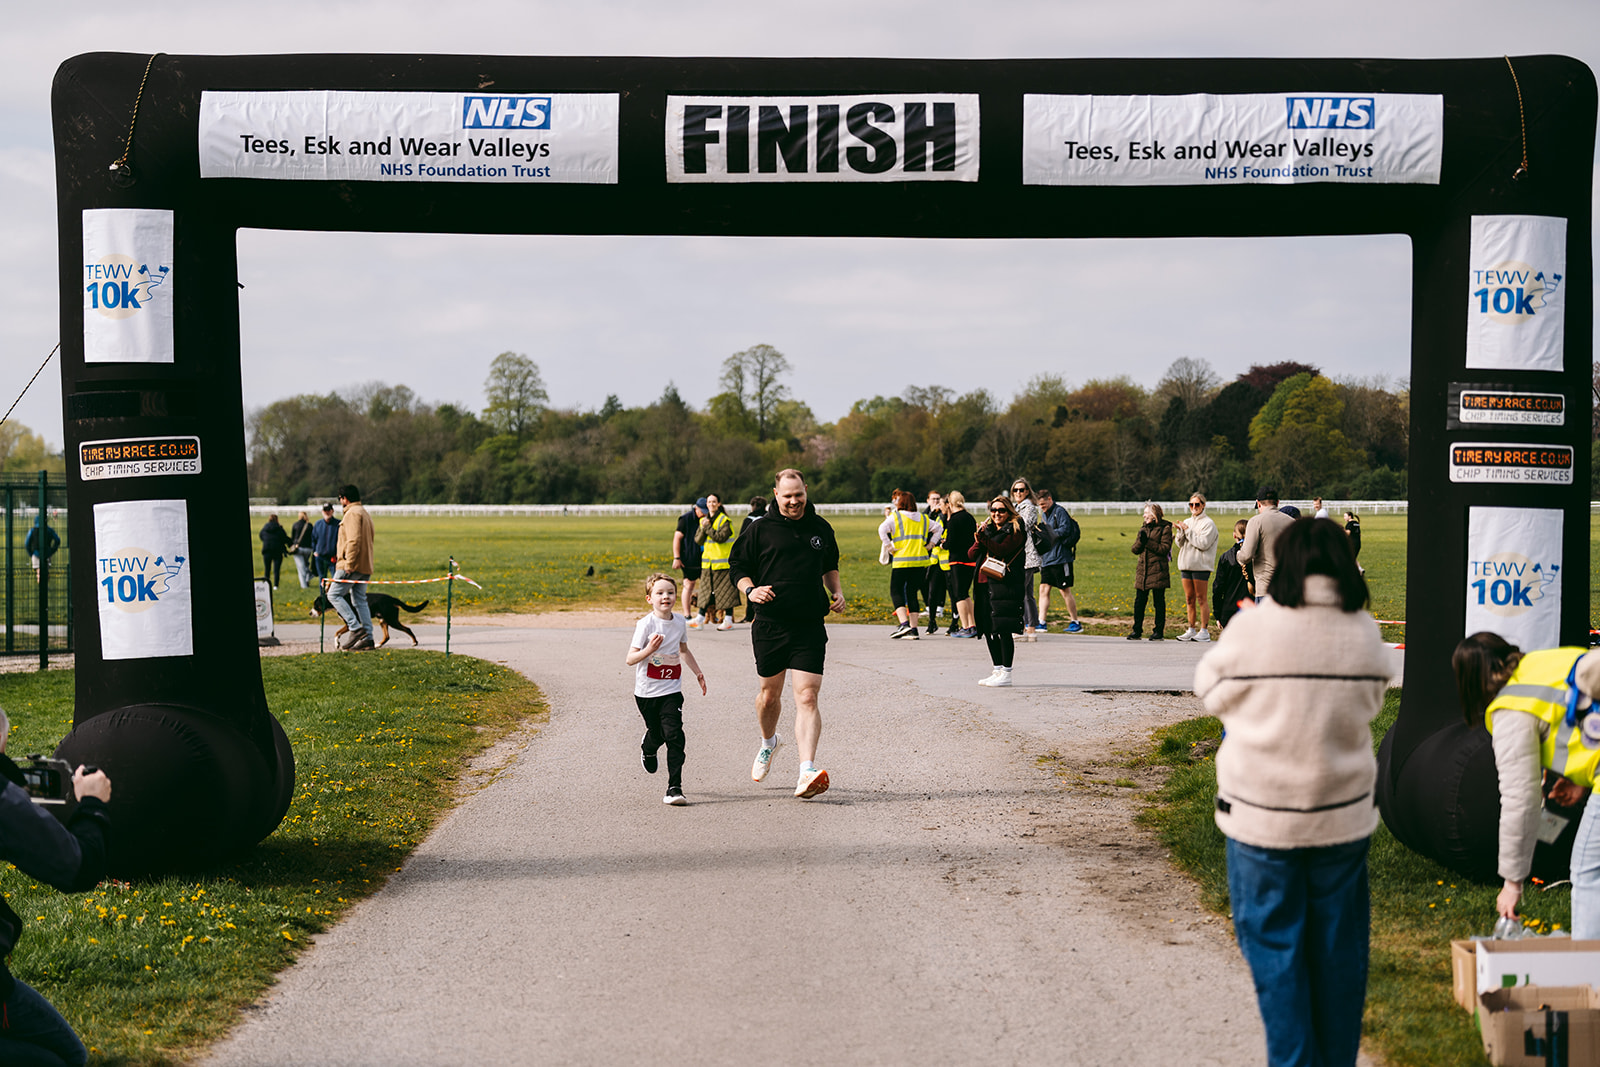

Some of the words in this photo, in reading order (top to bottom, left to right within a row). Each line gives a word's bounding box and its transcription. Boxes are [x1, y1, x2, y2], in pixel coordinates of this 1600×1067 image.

[464, 98, 549, 127] NHS
[1289, 98, 1373, 128] NHS
[683, 102, 956, 174] FINISH
[240, 135, 295, 156] Tees,
[304, 136, 341, 156] Esk
[349, 136, 391, 156] and
[400, 137, 461, 157] Wear
[468, 137, 550, 162] Valleys
[1064, 140, 1120, 162] Tees,
[1129, 140, 1166, 160] Esk
[1174, 139, 1217, 160] and
[1225, 139, 1286, 159] Wear
[1293, 137, 1374, 162] Valleys
[380, 163, 413, 176] NHS
[418, 163, 509, 177] Foundation
[512, 164, 551, 178] Trust
[1204, 166, 1237, 179] NHS
[1243, 165, 1329, 178] Foundation
[1335, 165, 1373, 178] Trust
[85, 264, 133, 279] TEWV
[1473, 270, 1530, 285] TEWV
[86, 281, 142, 309] 10k
[1474, 287, 1536, 315] 10k
[1465, 411, 1486, 420] CHIP
[1489, 411, 1519, 422] TIMING
[1521, 412, 1561, 424] SERVICES
[85, 465, 104, 477] CHIP
[107, 463, 140, 475] TIMING
[144, 461, 197, 473] SERVICES
[1456, 468, 1481, 479] CHIP
[1485, 468, 1520, 480] TIMING
[1524, 469, 1570, 481] SERVICES
[99, 556, 149, 573] TEWV
[1471, 561, 1527, 577] TEWV
[101, 573, 159, 603] 10k
[1471, 578, 1533, 607] 10k
[660, 668, 673, 679] 12
